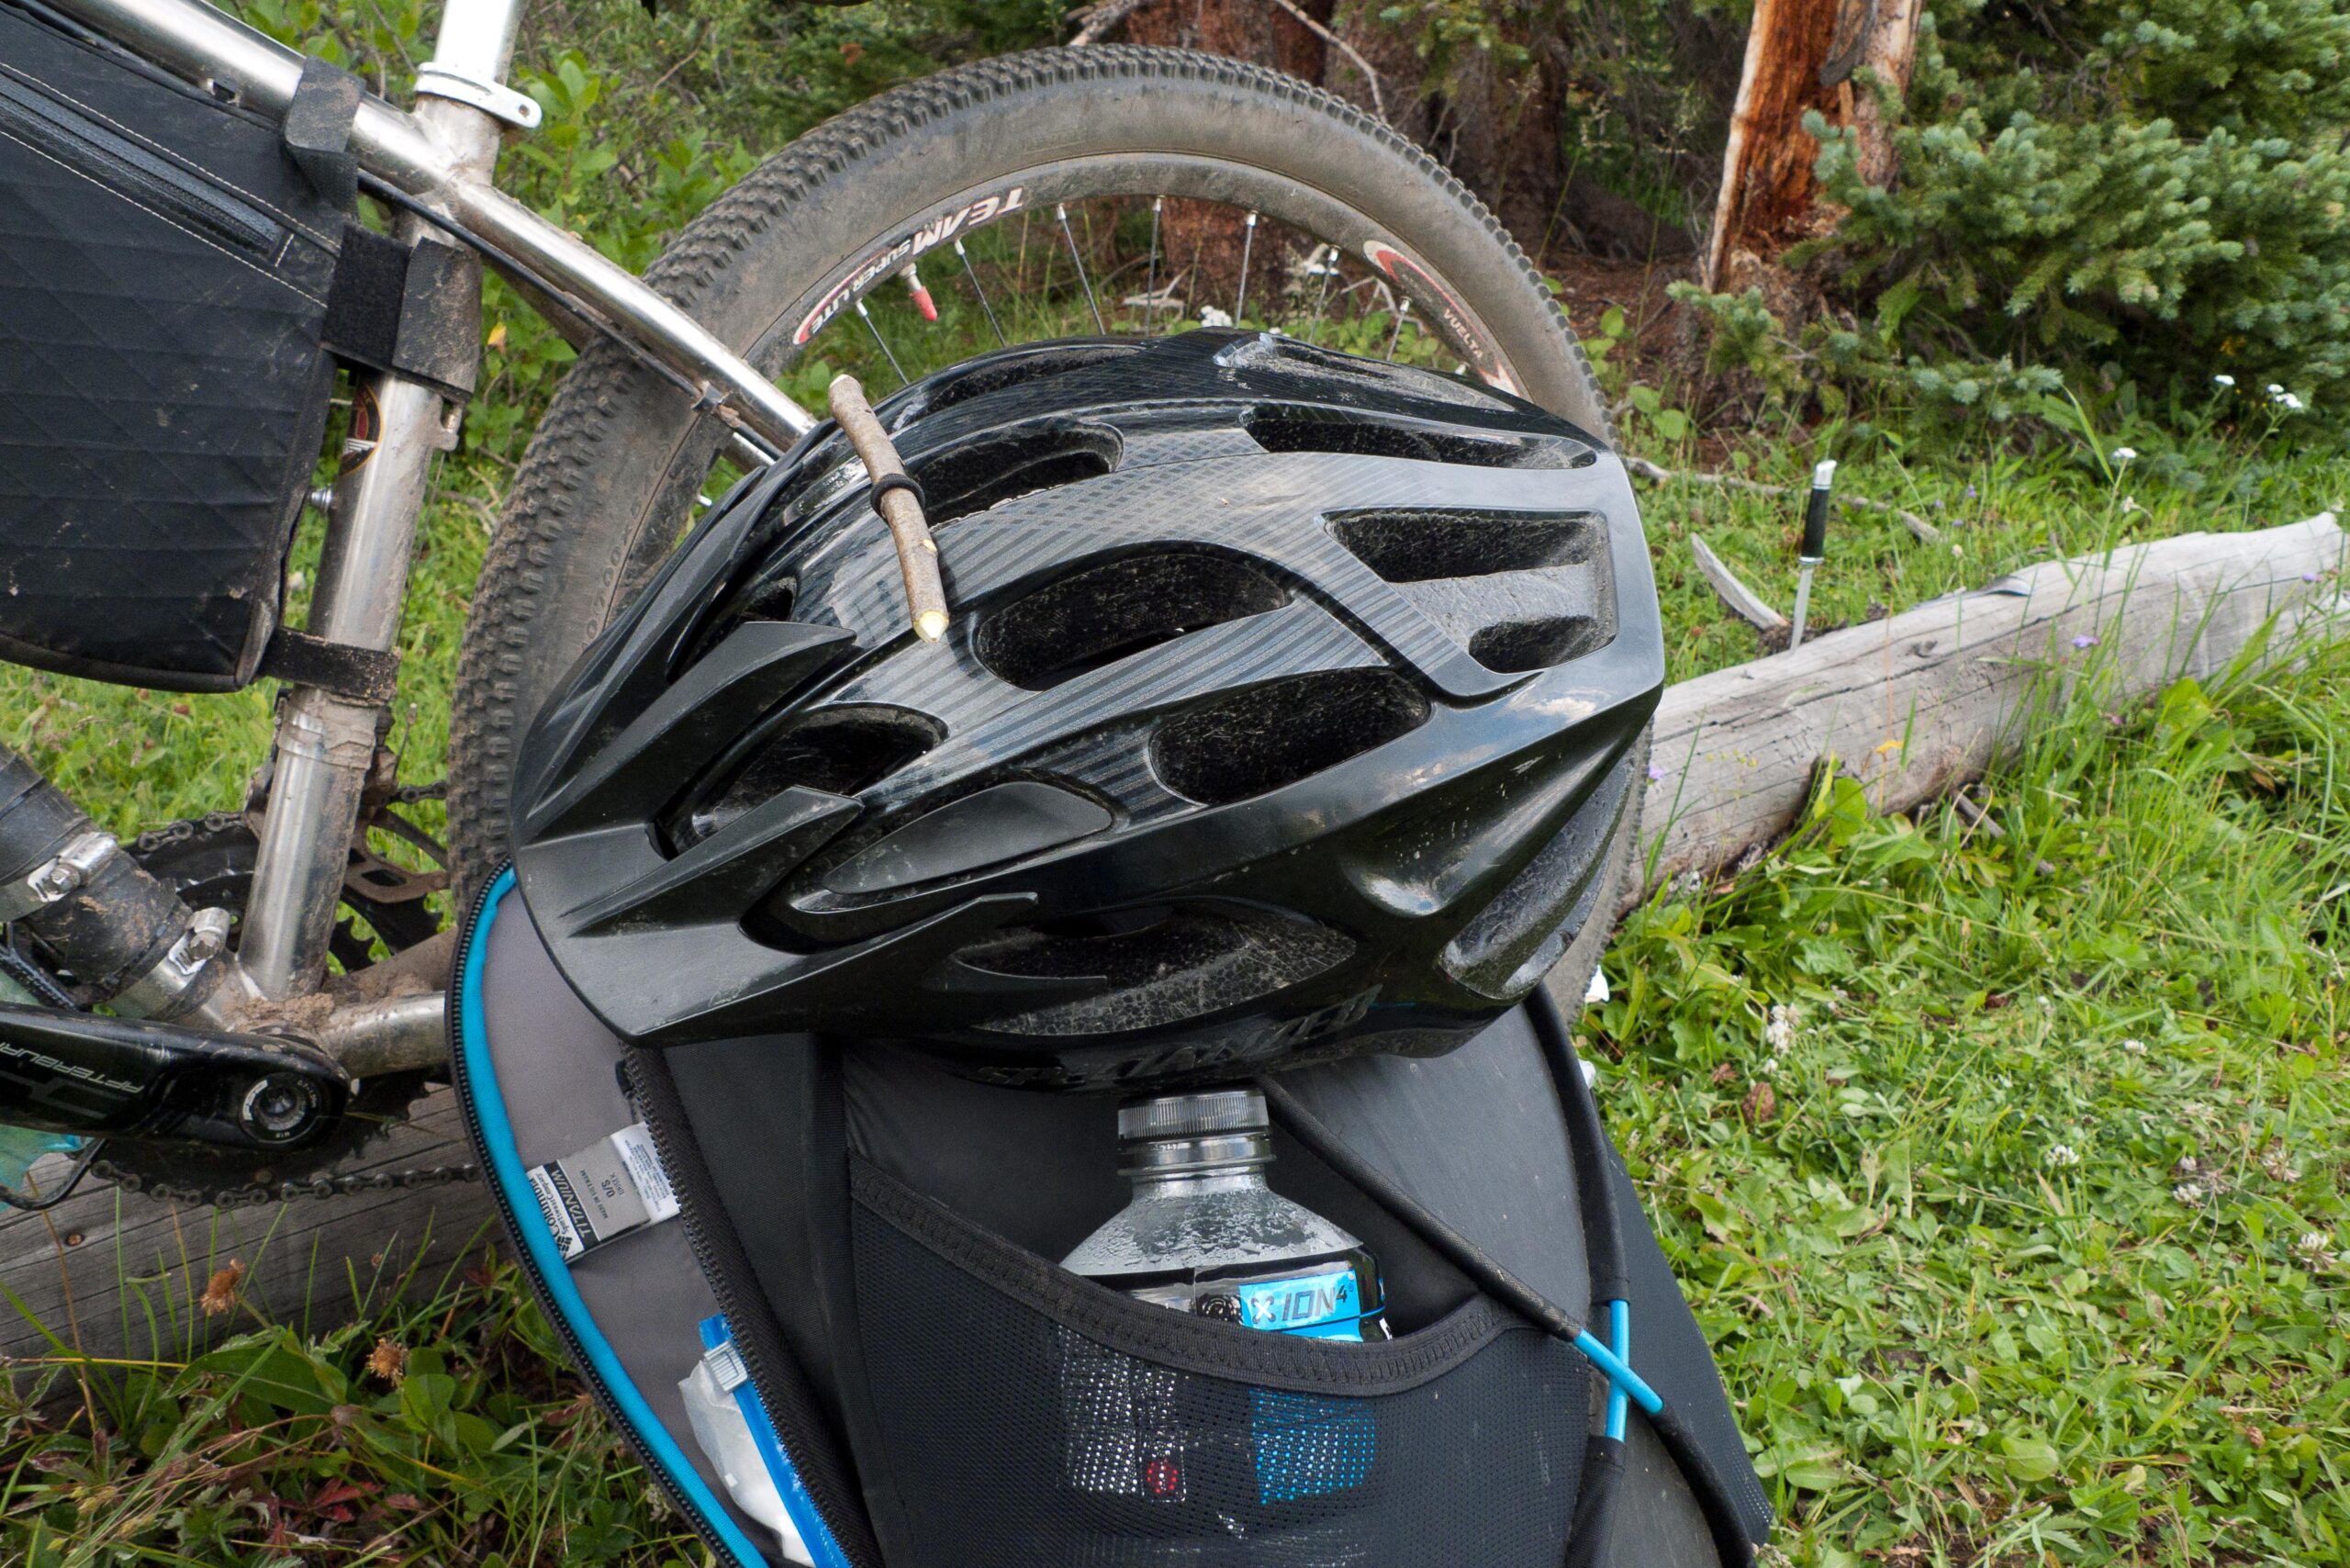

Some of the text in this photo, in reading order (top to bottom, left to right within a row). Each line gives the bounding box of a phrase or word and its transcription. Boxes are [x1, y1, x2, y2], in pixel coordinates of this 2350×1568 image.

[811, 186, 1024, 334] TEAM SUPER LITE
[1442, 308, 1483, 359] VUELTA
[550, 1169, 590, 1238] TITANIUM
